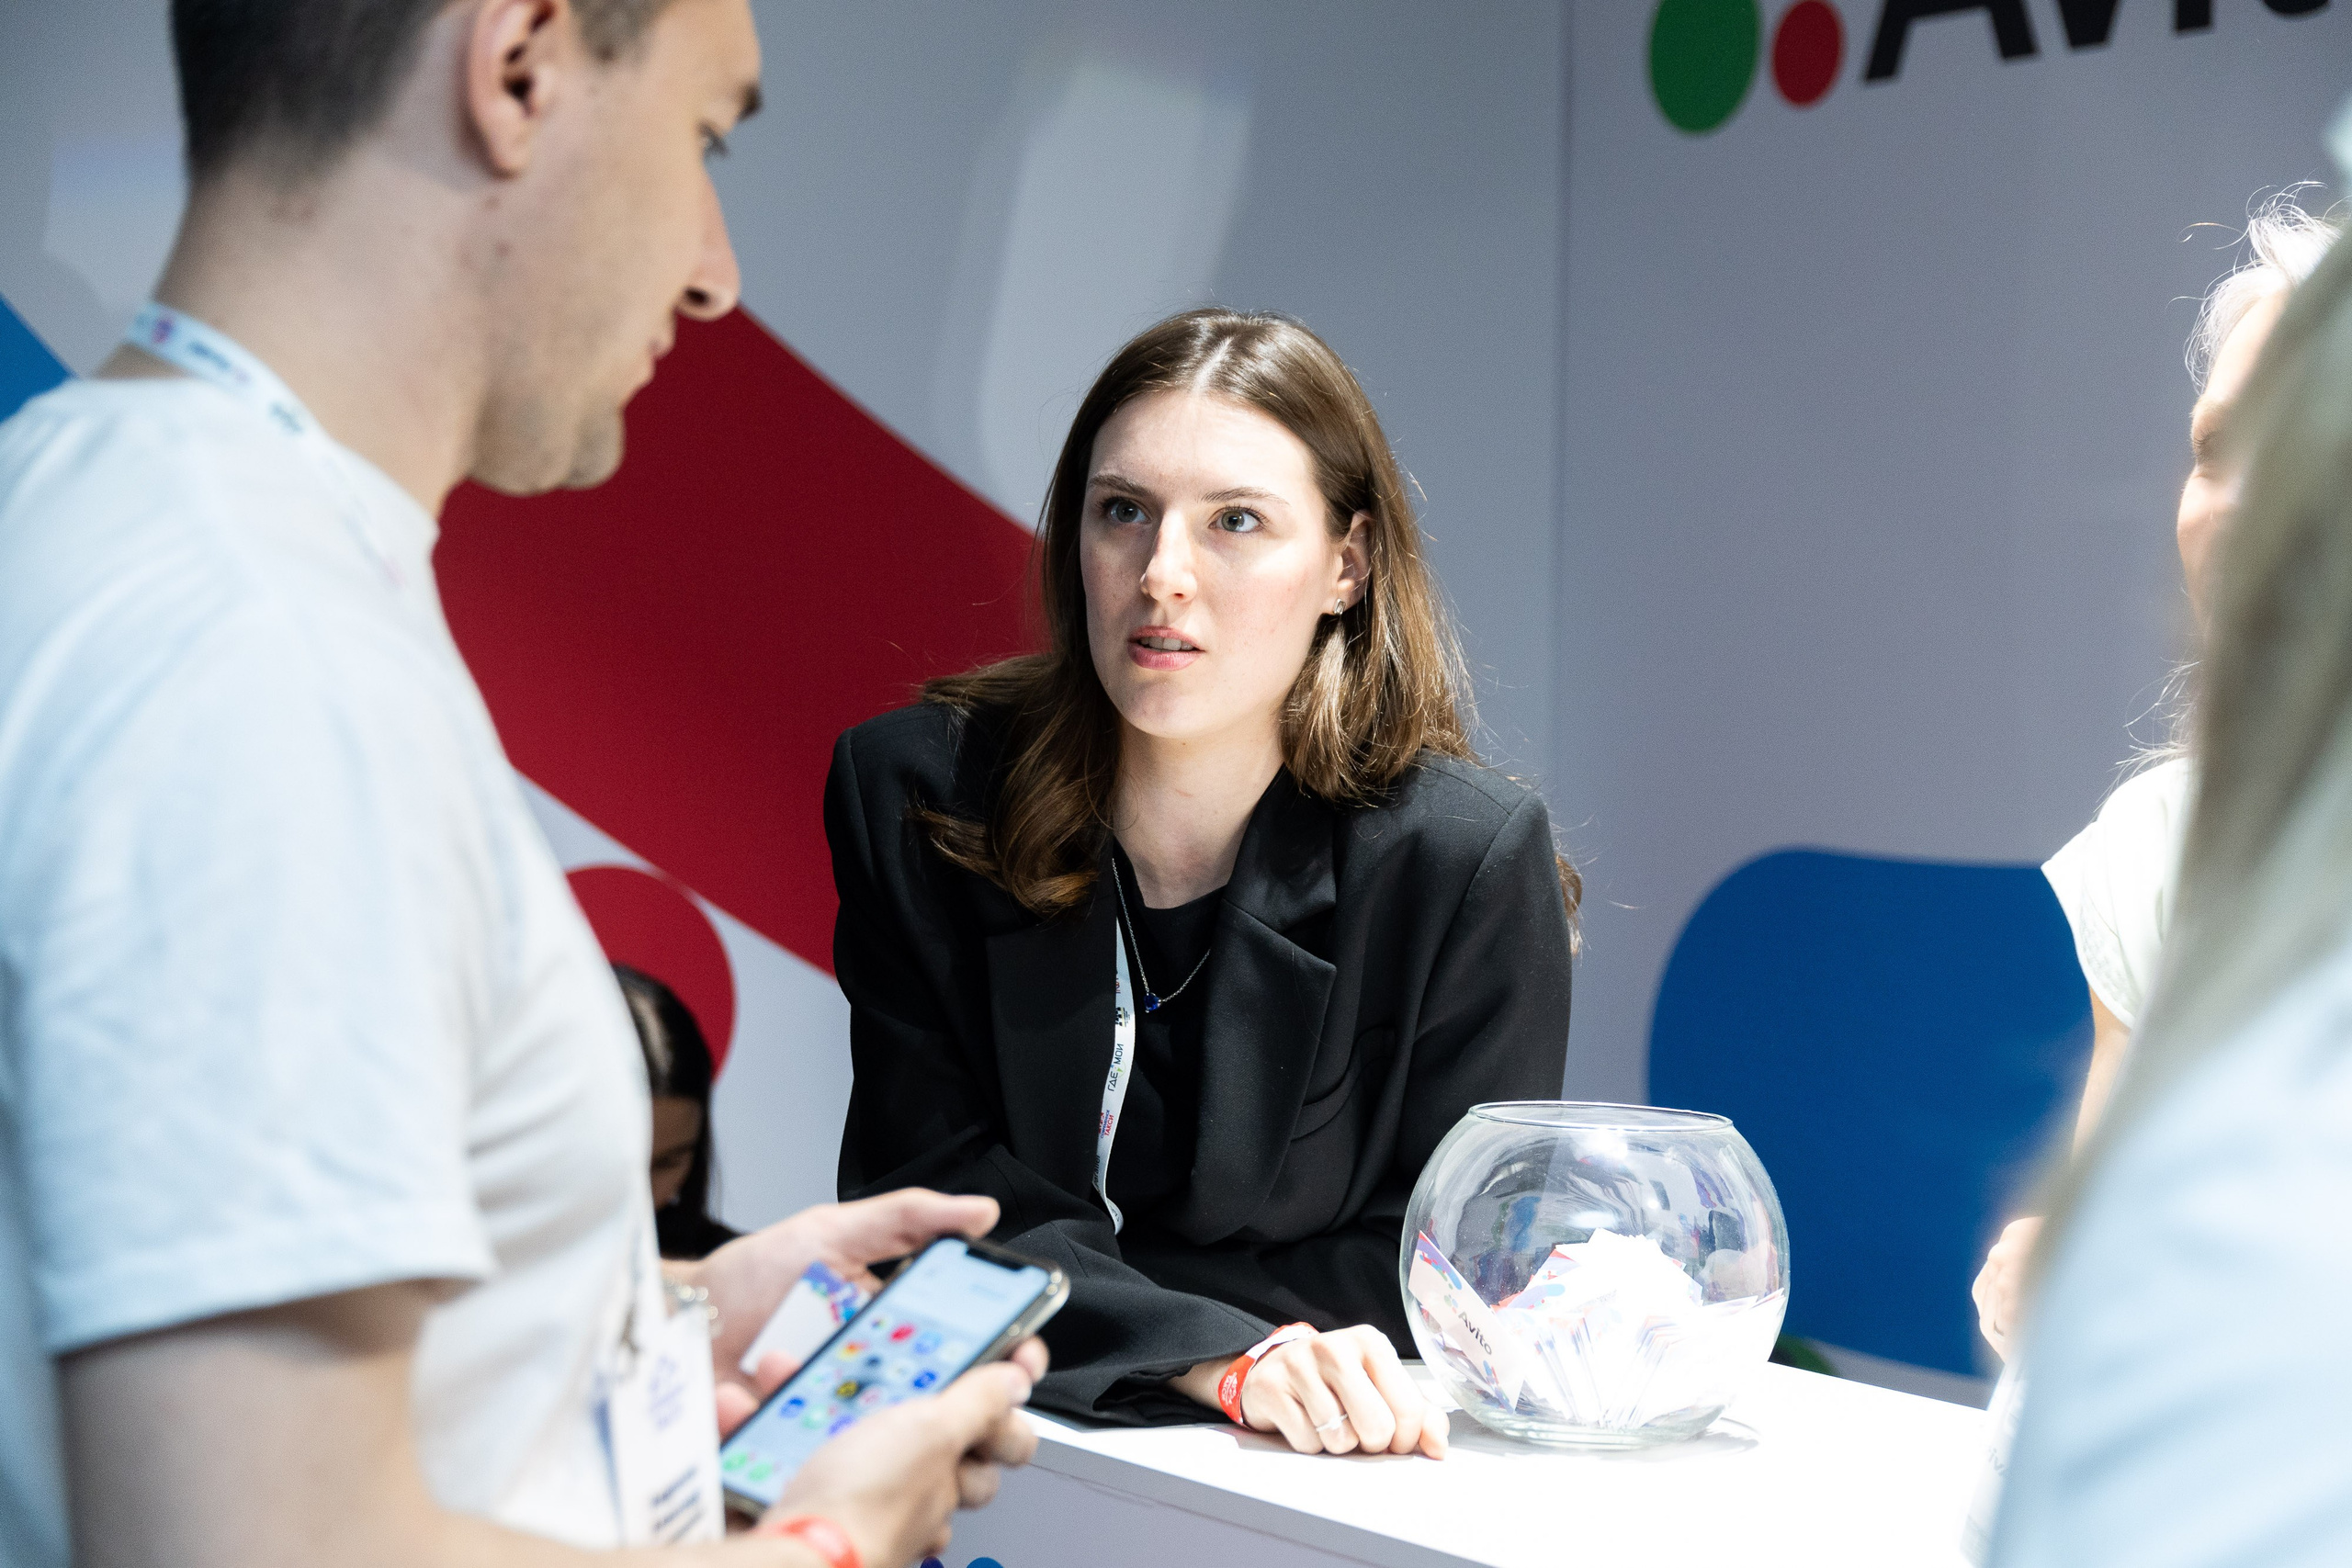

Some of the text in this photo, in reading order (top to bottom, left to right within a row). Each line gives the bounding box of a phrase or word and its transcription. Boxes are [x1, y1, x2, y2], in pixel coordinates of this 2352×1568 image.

[1107, 1071, 1118, 1091] ГДЕ
[1104, 1114, 1114, 1135] ТАКСИ
[1458, 1311, 1492, 1355] Avito
